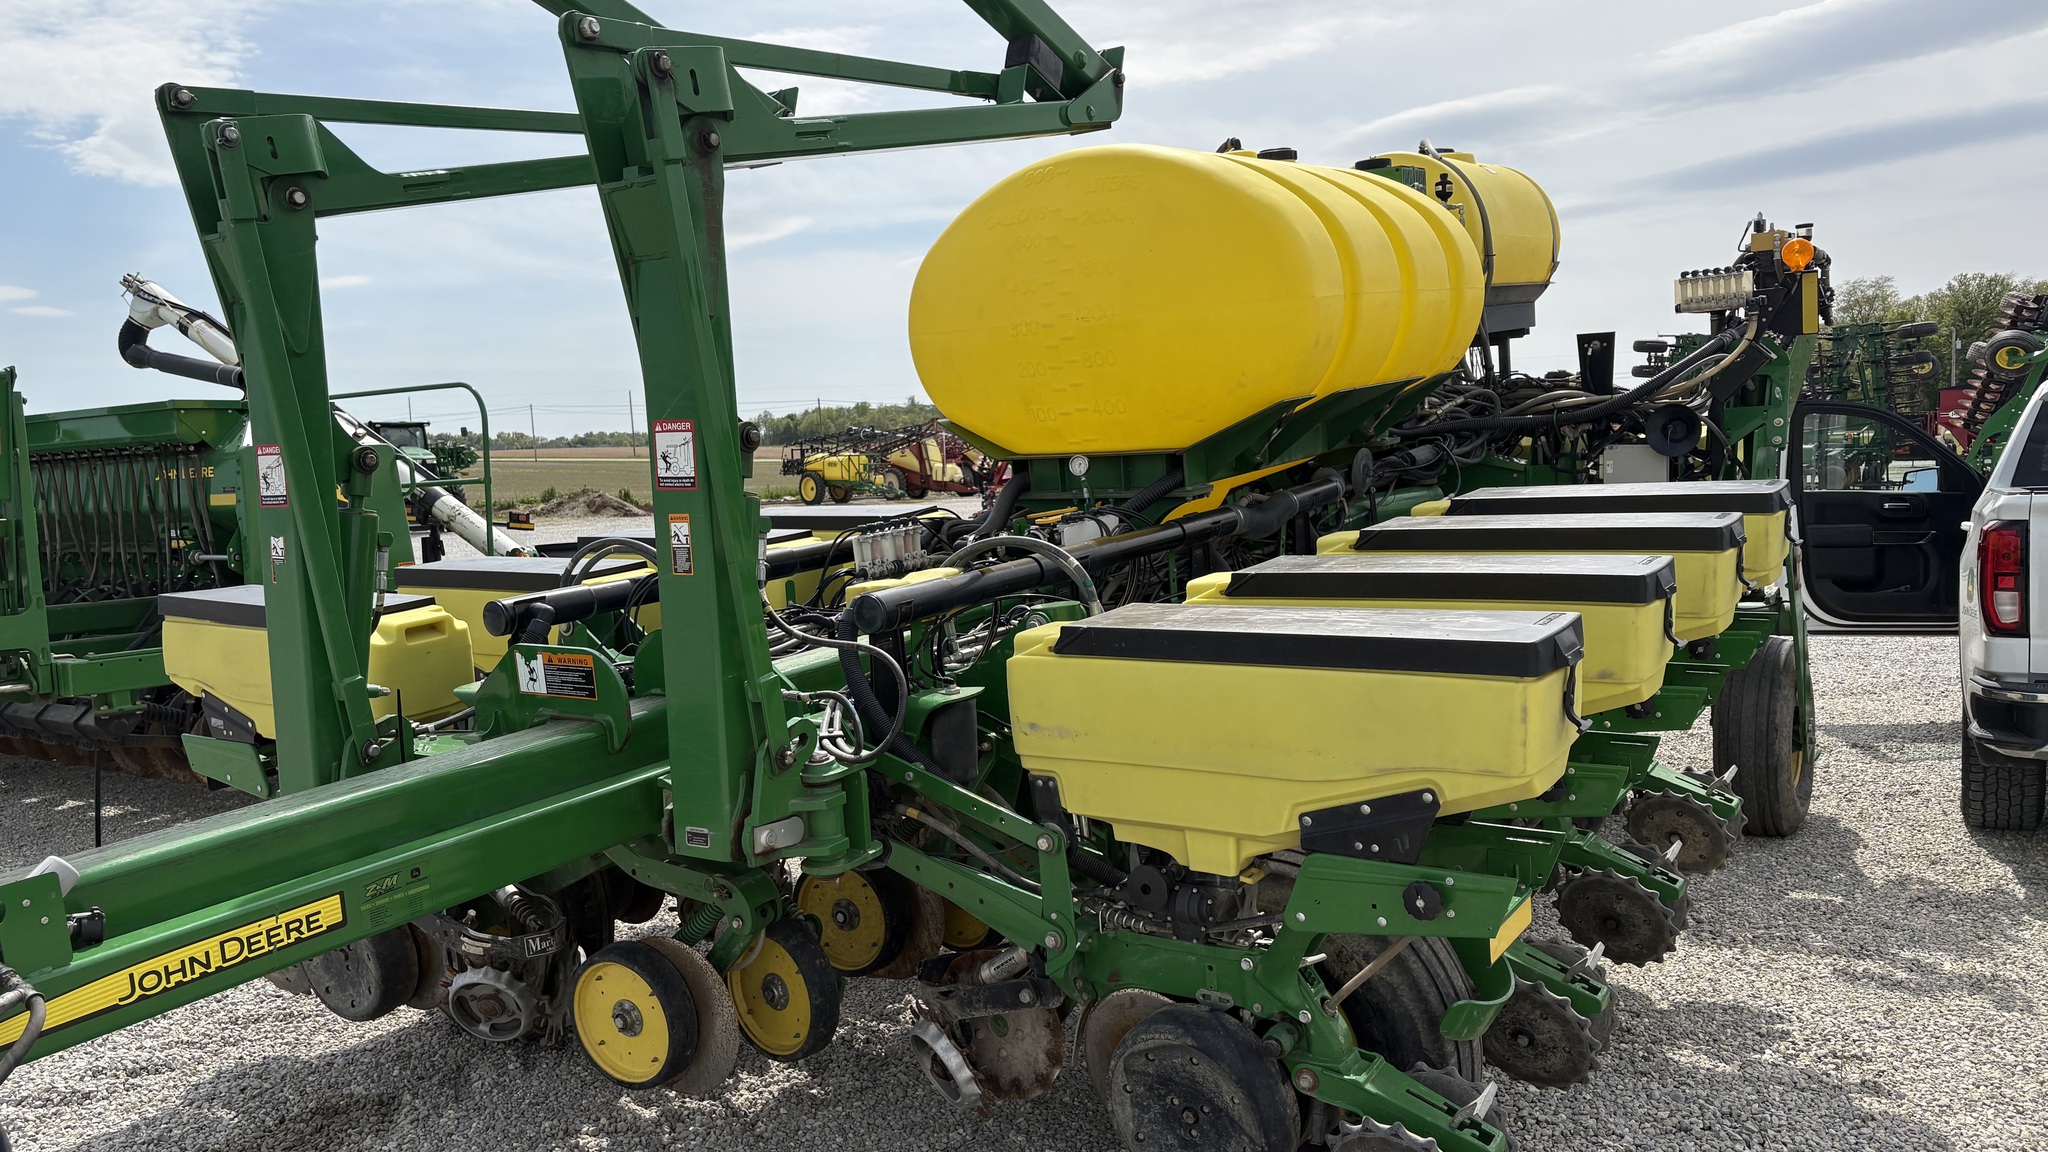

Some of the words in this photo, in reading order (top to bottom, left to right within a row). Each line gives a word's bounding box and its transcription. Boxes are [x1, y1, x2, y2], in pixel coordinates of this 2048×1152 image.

[1023, 166, 1054, 187] 600
[1084, 173, 1142, 194] LITERS
[986, 205, 1048, 230] GALLONS
[1080, 207, 1126, 226] 2000
[1014, 232, 1044, 251] 500
[1078, 259, 1118, 277] 1600
[1008, 278, 1039, 296] 400
[1075, 304, 1116, 323] 1200
[1010, 320, 1040, 339] 300
[1082, 350, 1116, 369] 800
[1016, 361, 1047, 379] 200
[1030, 406, 1057, 423] 100
[1092, 398, 1127, 416] 400
[662, 422, 691, 431] DANGER
[262, 446, 281, 454] DANGE
[557, 657, 588, 665] WARNING
[118, 950, 212, 1003] JOHN
[219, 910, 324, 965] DEERE
